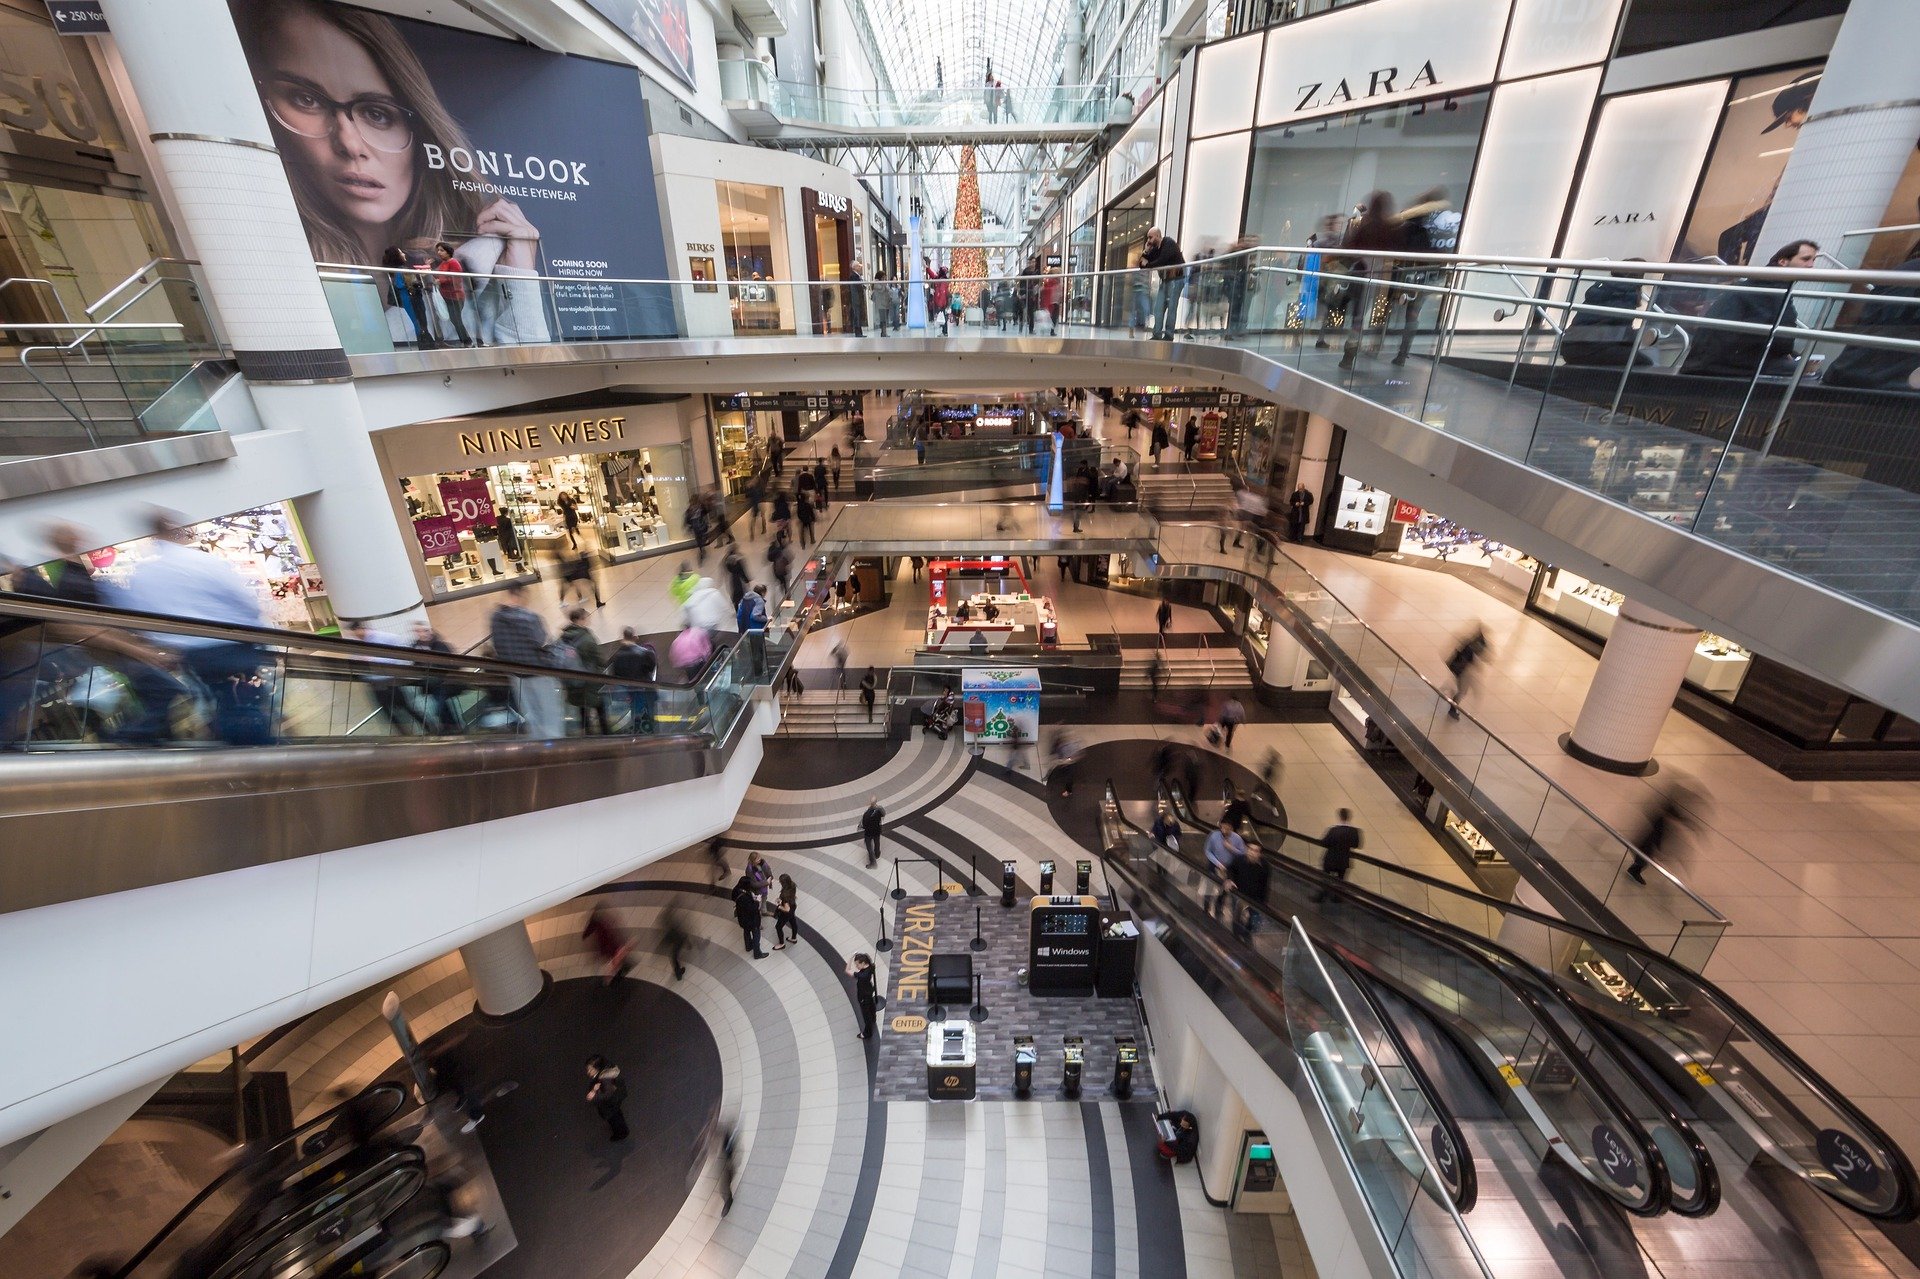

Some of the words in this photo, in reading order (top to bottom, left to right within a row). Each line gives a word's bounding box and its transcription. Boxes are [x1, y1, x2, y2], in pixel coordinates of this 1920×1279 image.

[69, 11, 87, 21] 250
[1294, 59, 1443, 112] ZARA
[423, 143, 590, 186] BONLOOK
[452, 180, 529, 197] FASHIONABLE
[530, 187, 577, 201] EYEWEAR
[818, 190, 847, 213] BIRKS
[1593, 212, 1655, 226] ZARA
[687, 242, 715, 253] BIRKS
[552, 260, 584, 268] COMING
[586, 261, 608, 269] SOON
[585, 269, 603, 277] NOW
[460, 427, 542, 455] NINE
[552, 418, 627, 446] WEST
[447, 497, 490, 523] 50%
[422, 530, 455, 549] 30%
[904, 903, 936, 932] VR
[1052, 947, 1090, 956] Windows
[897, 936, 934, 1001] ZONE
[895, 1020, 923, 1028] ENTER
[944, 1076, 960, 1087] hp
[1604, 1131, 1632, 1168] Level
[1834, 1135, 1872, 1173] Level
[1439, 1149, 1452, 1174] 2
[1603, 1150, 1619, 1174] 2
[1832, 1154, 1855, 1179] 2
